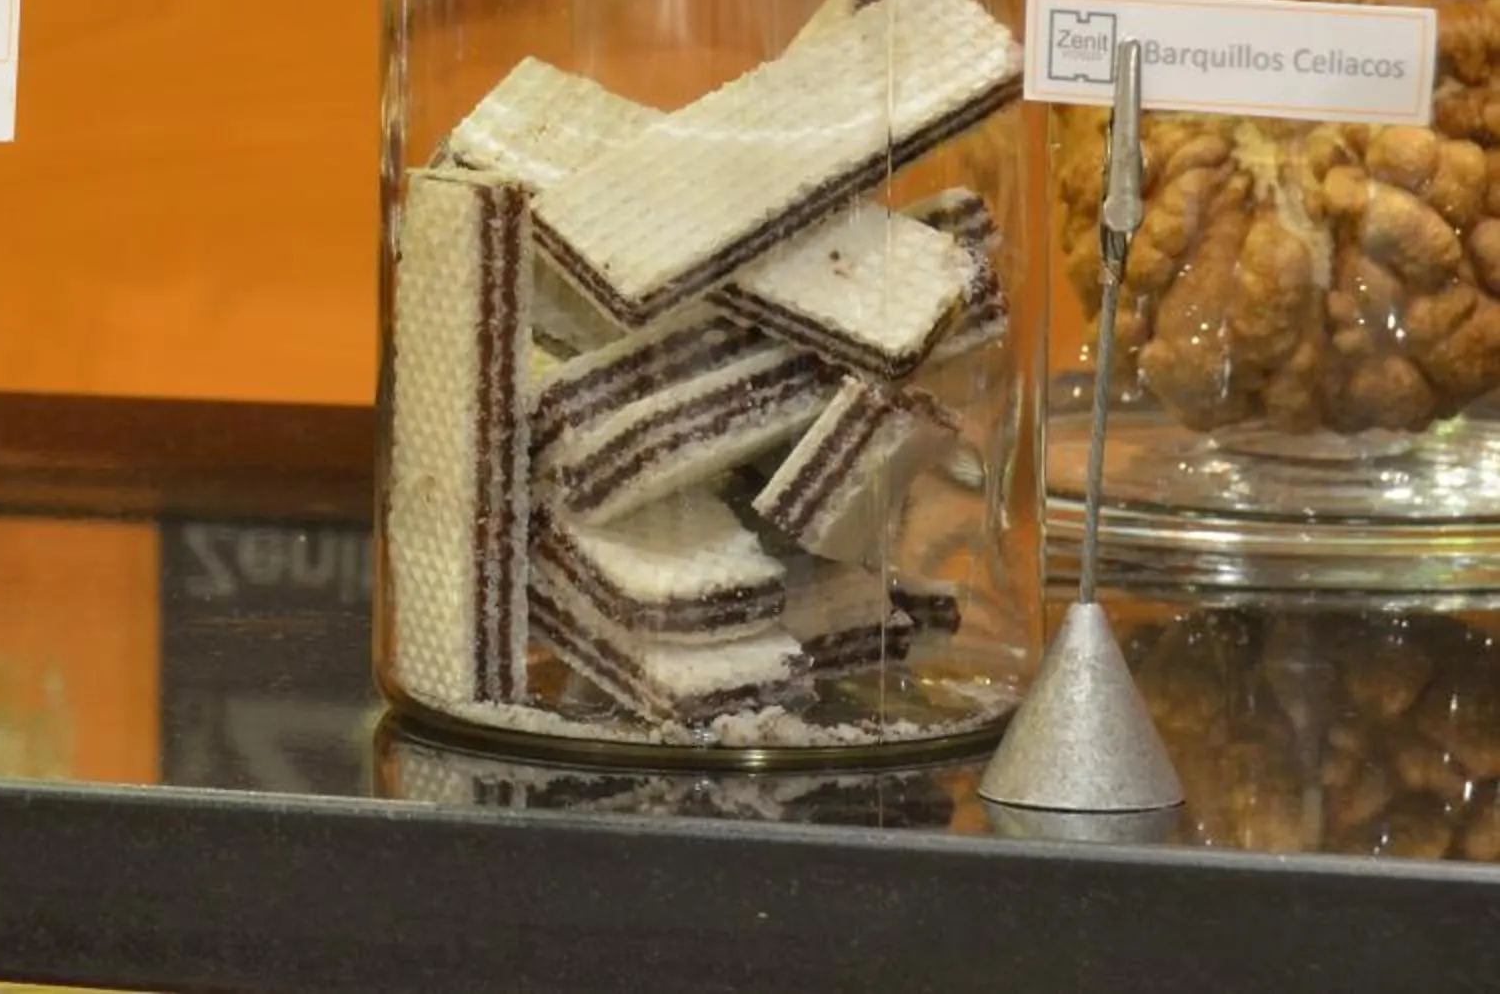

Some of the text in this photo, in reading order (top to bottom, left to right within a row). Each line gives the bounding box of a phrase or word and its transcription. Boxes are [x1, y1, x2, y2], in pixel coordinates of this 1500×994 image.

[1057, 29, 1108, 52] Zenit
[1144, 40, 1406, 79] Barquillos Celiacos
